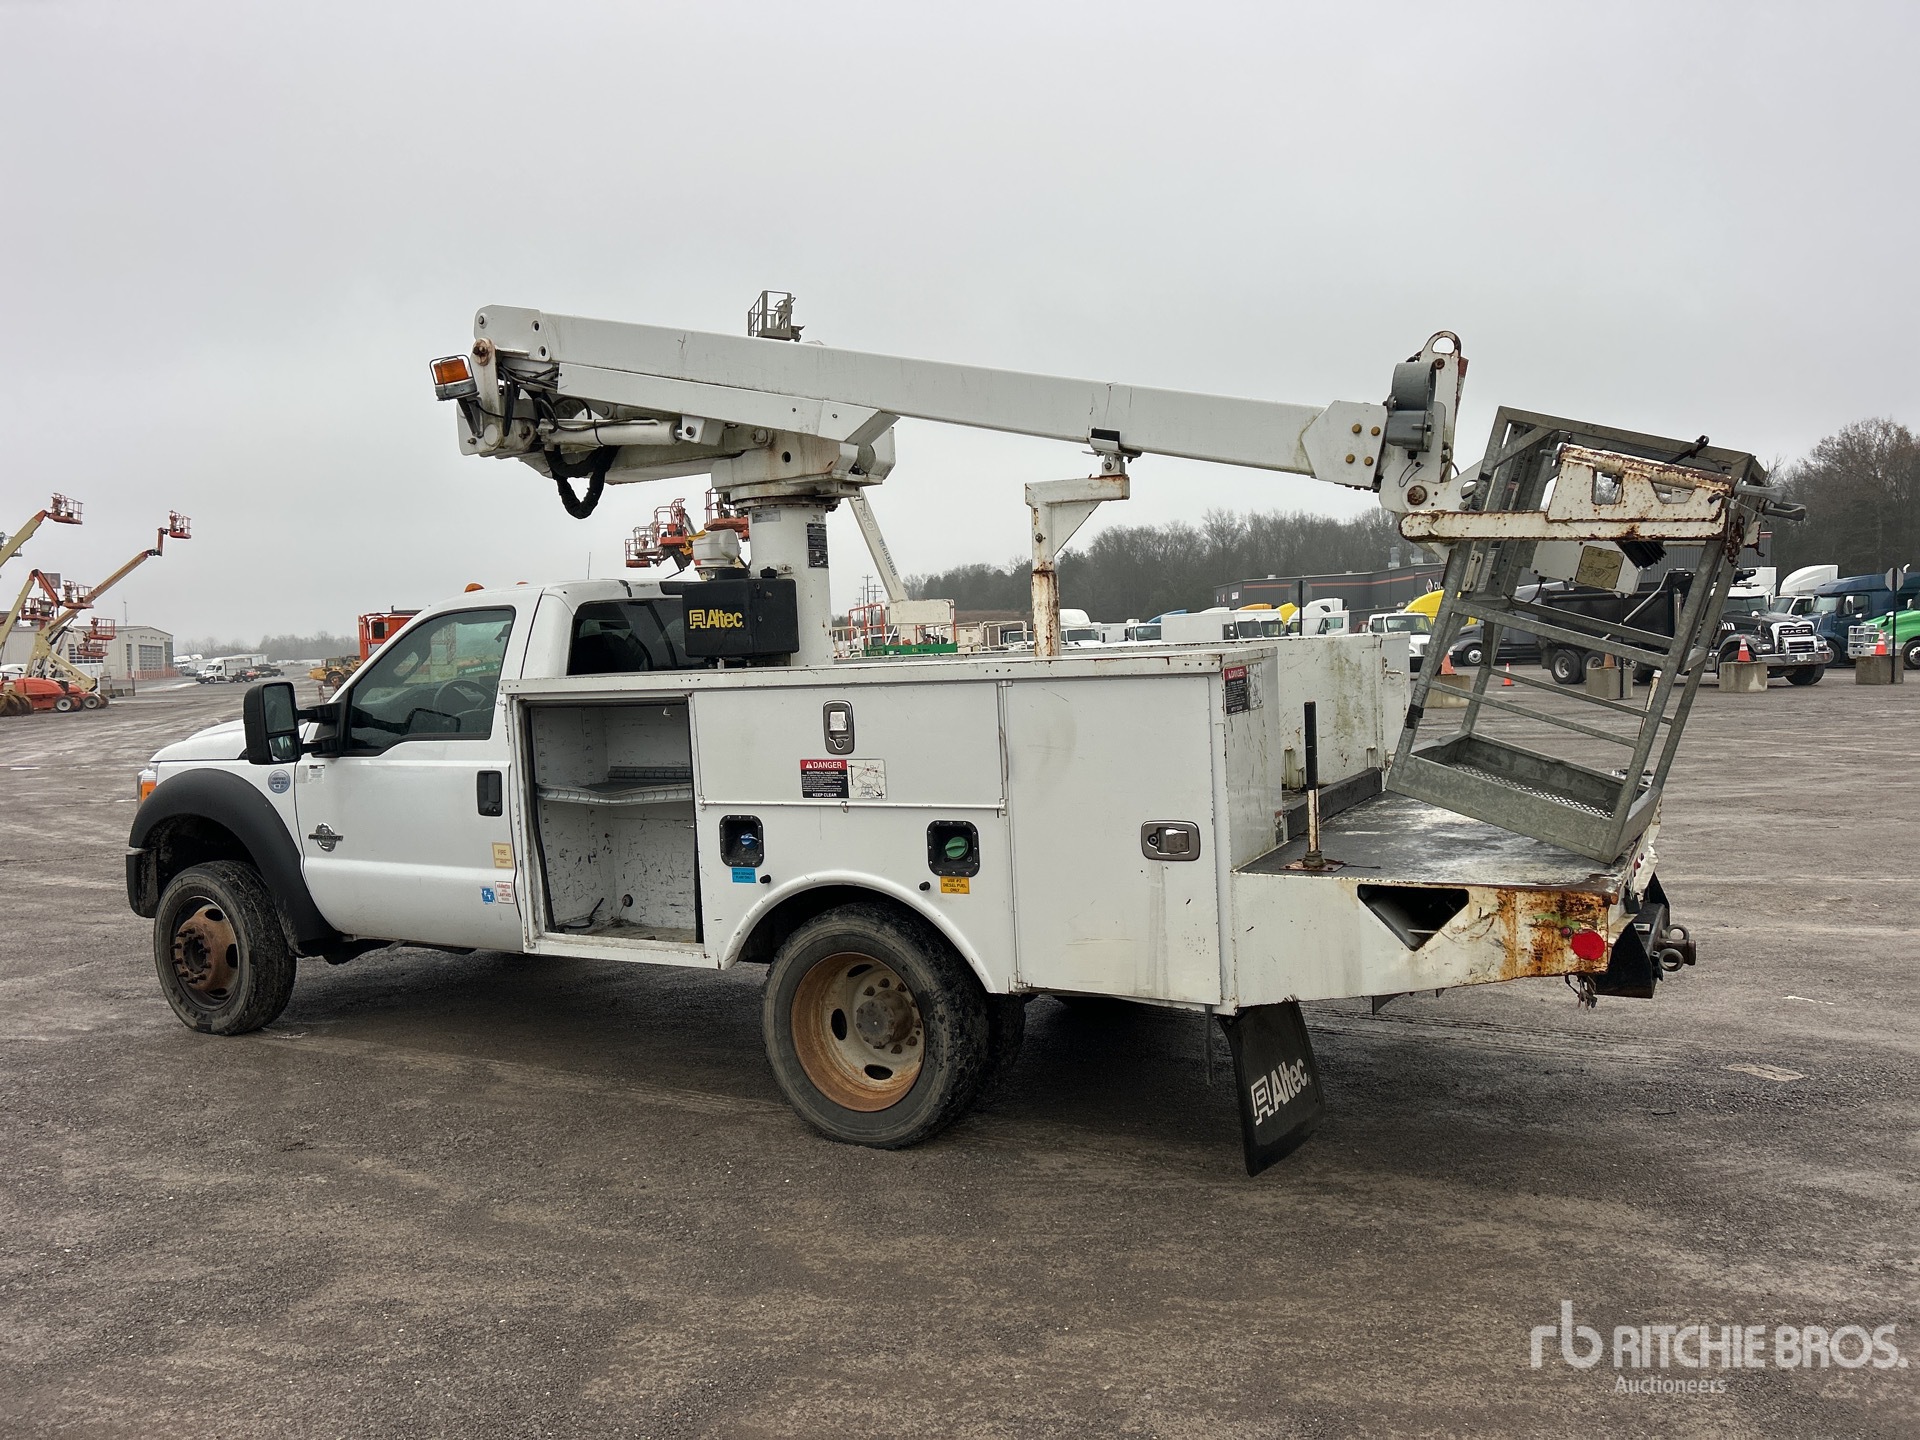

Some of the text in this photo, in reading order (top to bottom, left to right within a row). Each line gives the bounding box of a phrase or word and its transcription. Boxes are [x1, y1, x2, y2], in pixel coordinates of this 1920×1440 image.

[707, 609, 744, 629] Altec
[813, 761, 842, 769] DANGER
[1271, 1059, 1307, 1112] Altec
